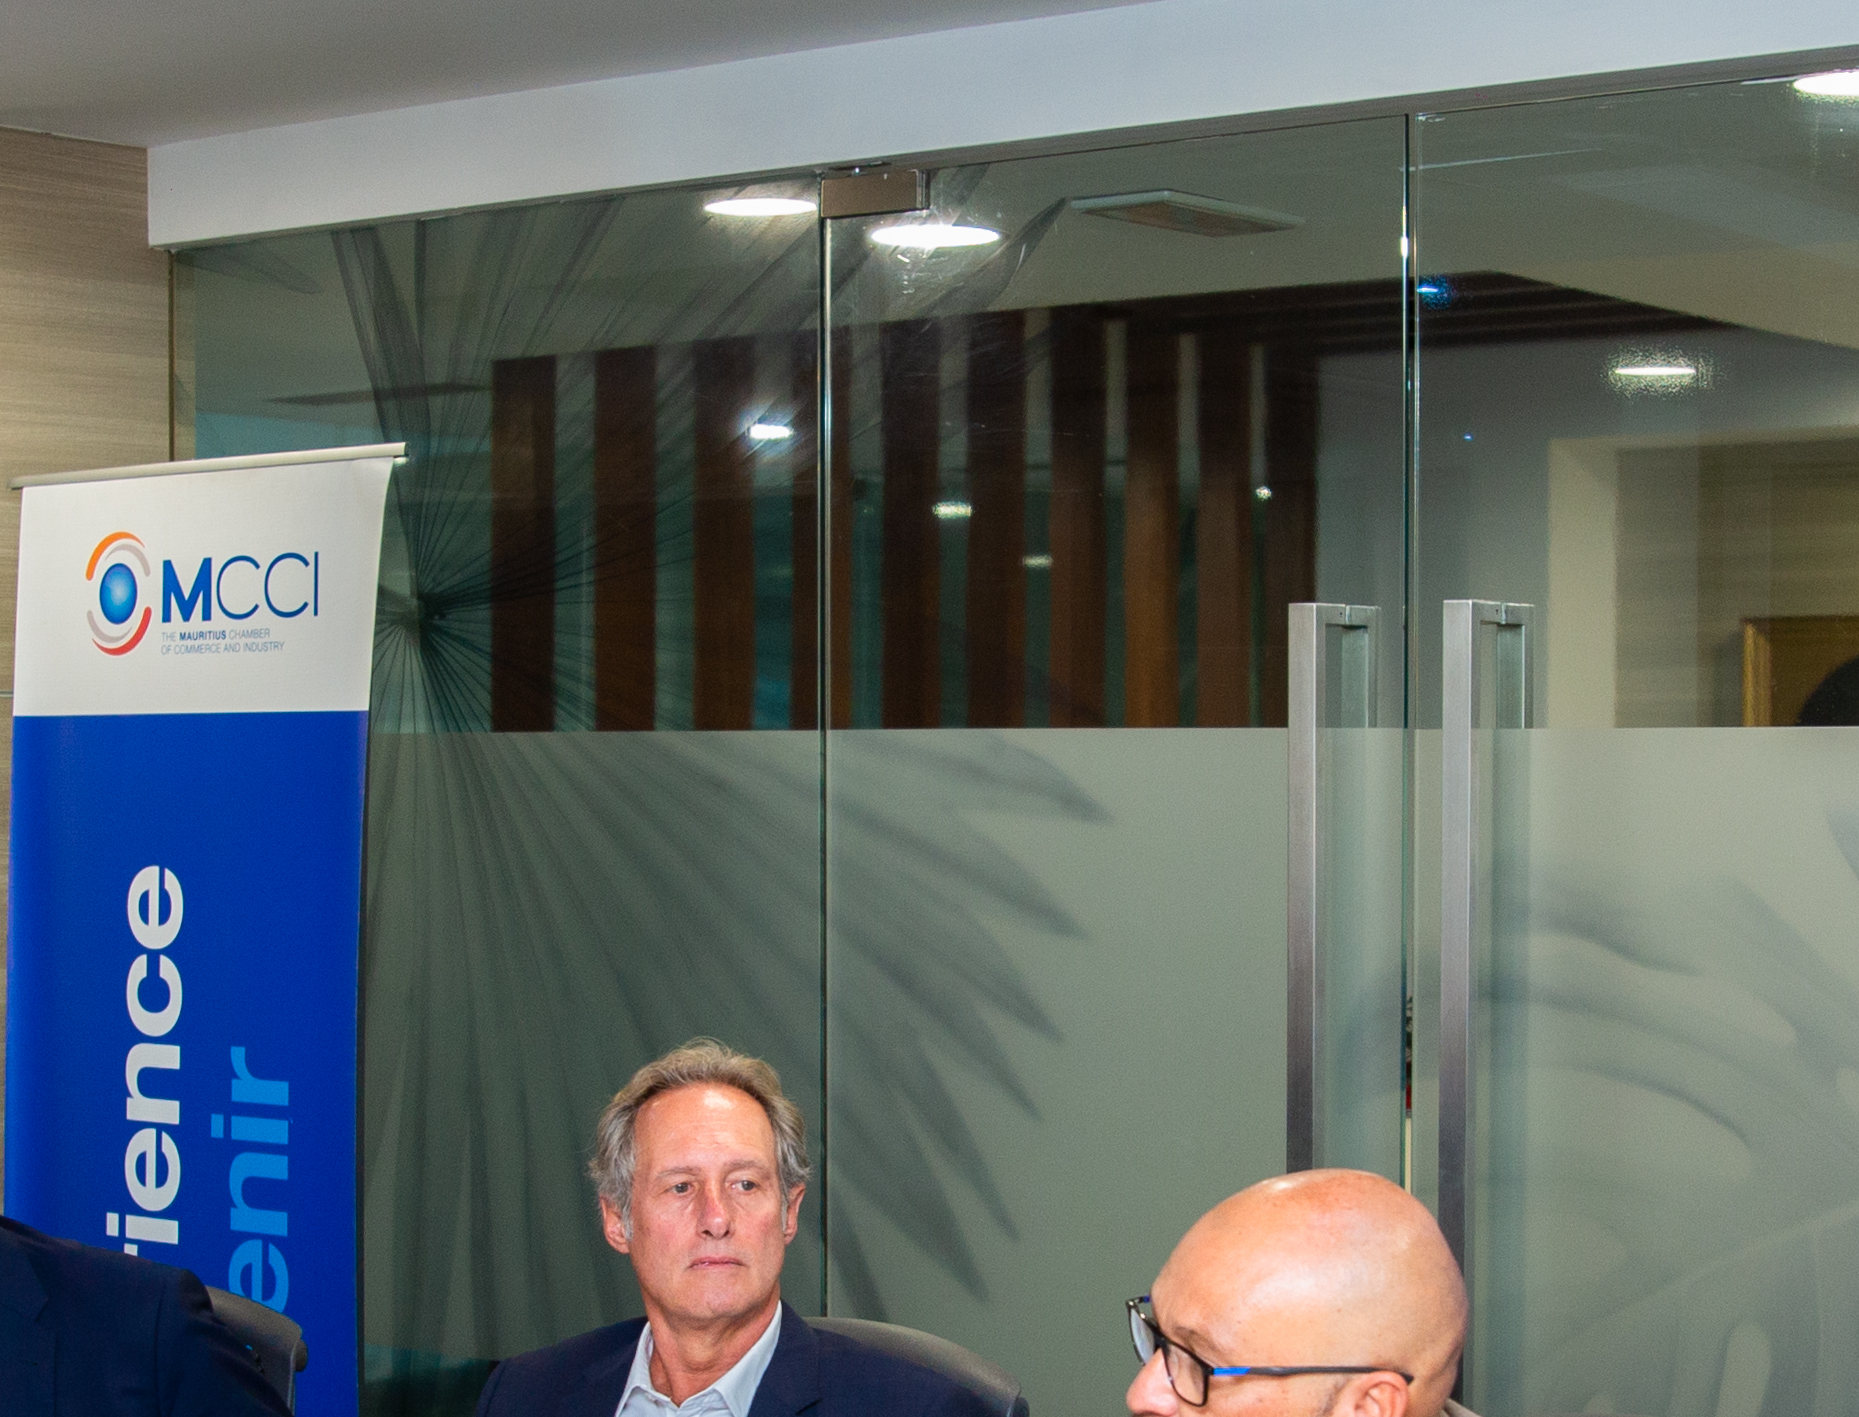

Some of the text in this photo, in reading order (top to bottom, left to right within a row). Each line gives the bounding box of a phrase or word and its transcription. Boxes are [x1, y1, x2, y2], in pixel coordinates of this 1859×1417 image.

[161, 551, 319, 623] MCCI
[161, 628, 270, 641] THE MAURITIUS CHAMBER
[161, 641, 284, 655] OF COMMERCE AND INDUSTRY
